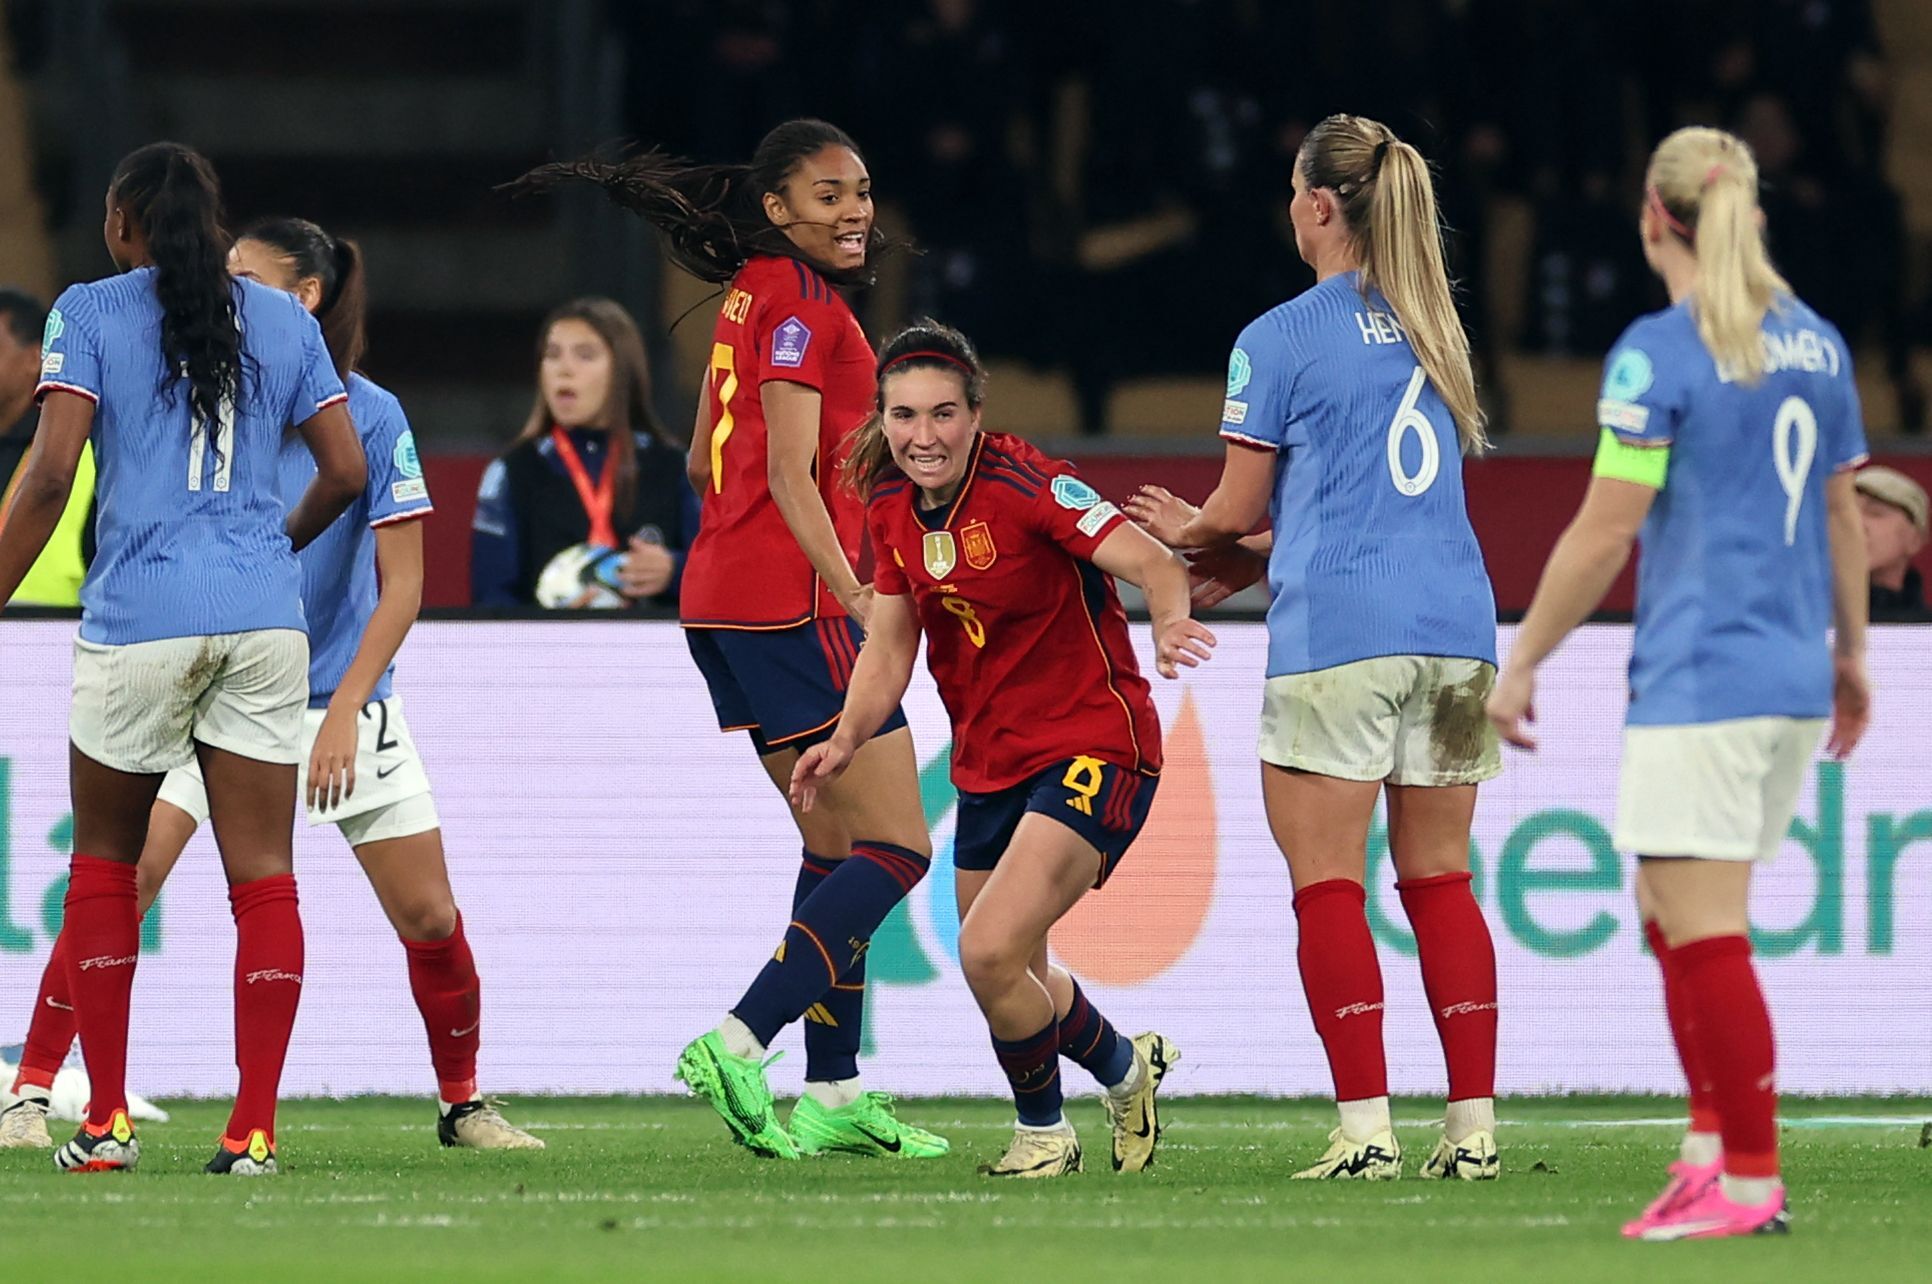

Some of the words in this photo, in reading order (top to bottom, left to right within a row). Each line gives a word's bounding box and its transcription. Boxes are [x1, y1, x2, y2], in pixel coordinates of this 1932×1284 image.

[1354, 311, 1403, 344] HEN
[1387, 366, 1440, 497] 6
[1773, 396, 1818, 547] 9
